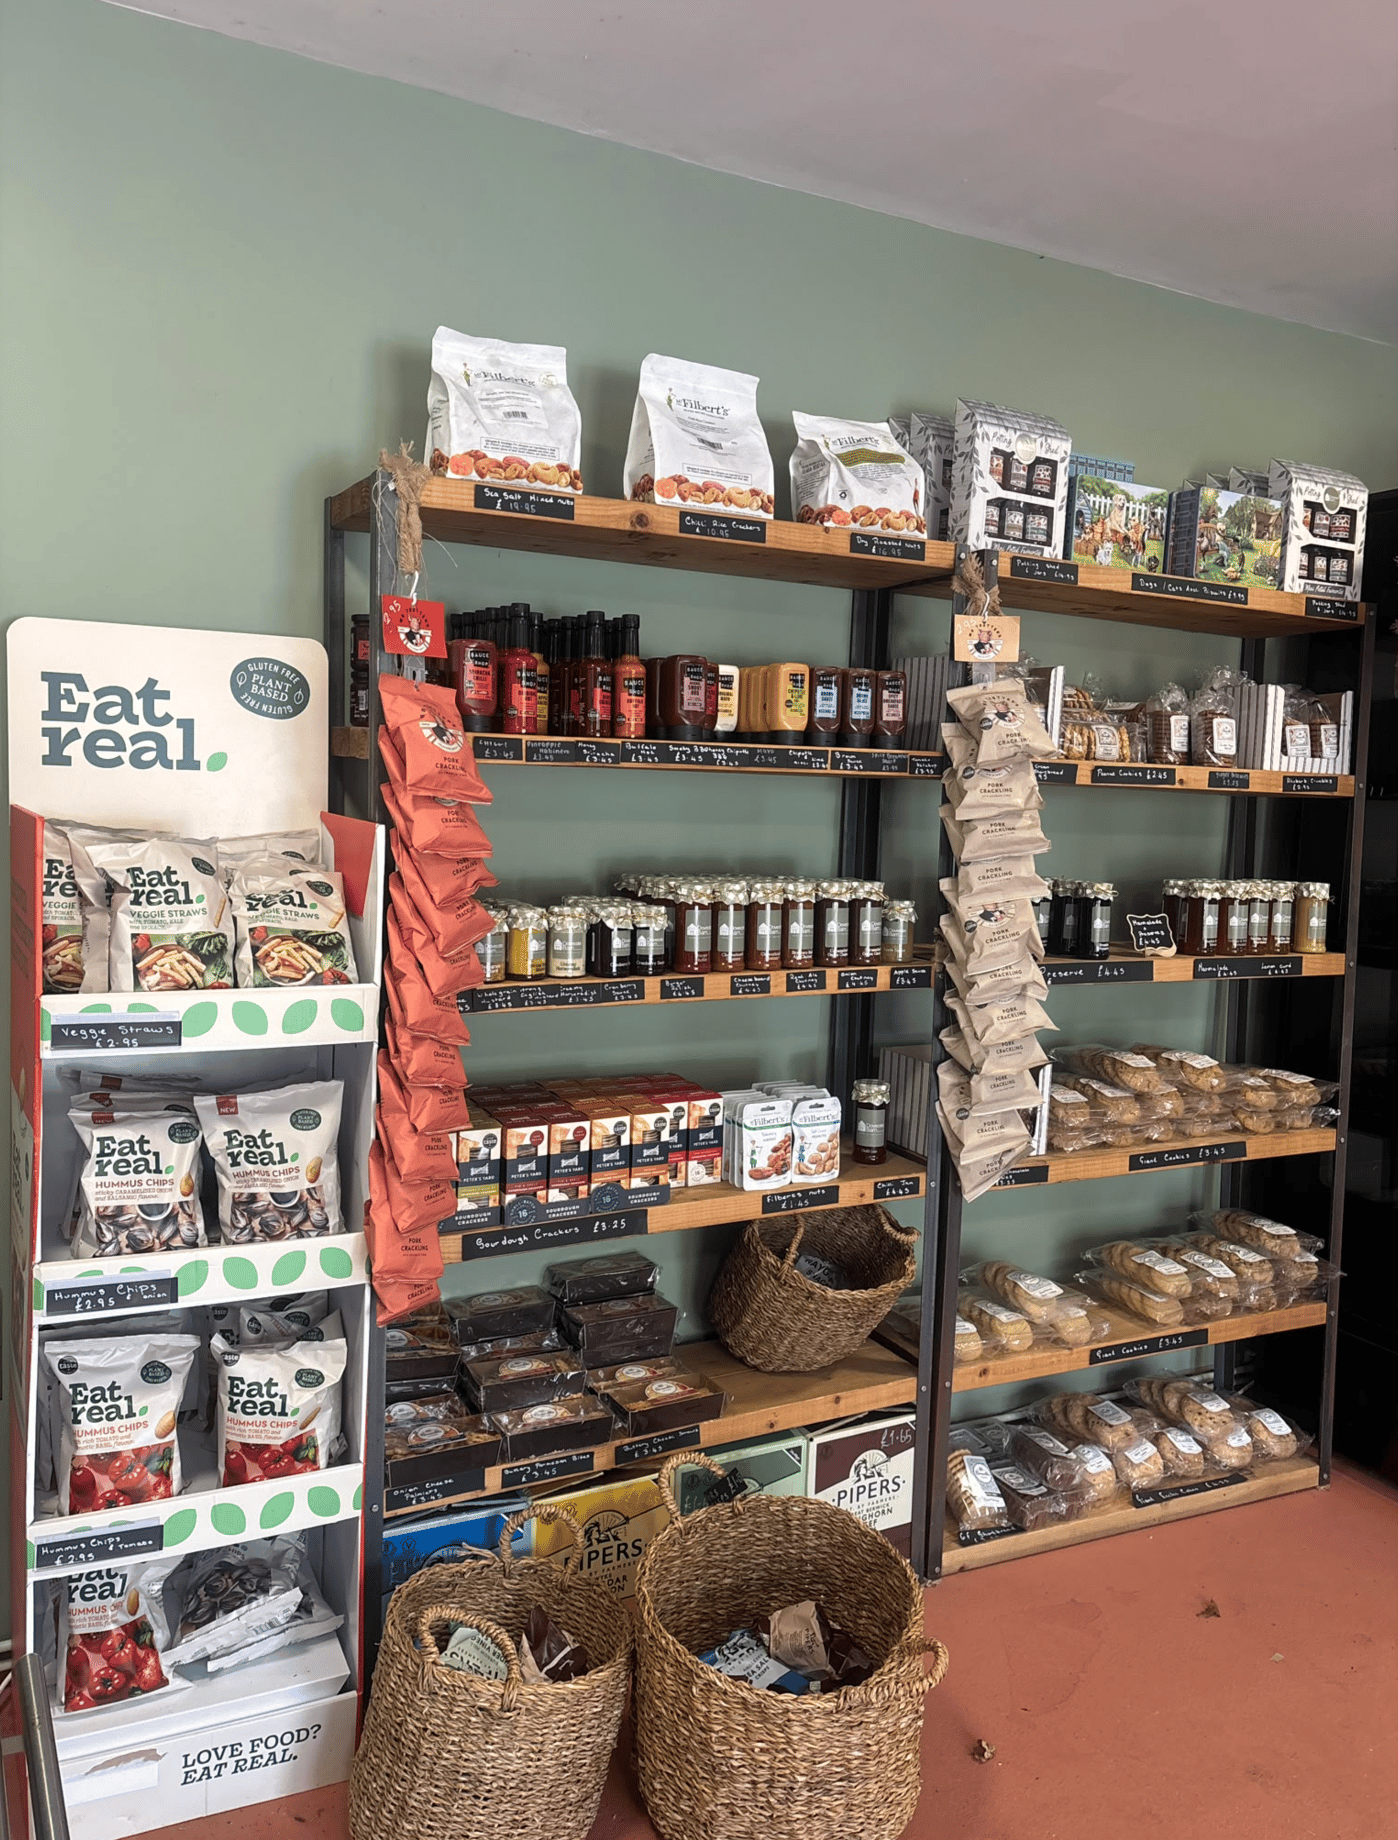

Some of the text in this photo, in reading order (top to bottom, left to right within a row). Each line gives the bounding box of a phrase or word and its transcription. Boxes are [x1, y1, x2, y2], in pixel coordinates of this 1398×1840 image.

[682, 398, 730, 417] Filbert's
[483, 487, 554, 504] Sea Salt Mixed
[711, 519, 761, 532] Rice Crackers
[855, 535, 902, 547] Dry Roasted
[247, 662, 301, 685] GLUTEN FREE
[251, 673, 293, 693] PLANT
[41, 671, 175, 727] Eat
[250, 683, 289, 702] BASED
[240, 692, 294, 715] GLUTEN FREE
[443, 755, 461, 765] PORK
[979, 787, 1014, 795] CRACKLING
[125, 865, 181, 888] Eat
[977, 870, 1014, 881] CRACKLING
[985, 866, 1003, 874] PORK
[129, 907, 208, 919] VEGGIE STRAWS
[282, 908, 320, 920] STRAWS
[985, 930, 1021, 945] CRACKLING
[991, 928, 1010, 937] PORK
[989, 968, 1023, 981] CRACKLING
[603, 982, 637, 992] Cranberry
[996, 1009, 1028, 1022] CRACKLING
[1001, 1006, 1019, 1014] PORK
[61, 1024, 174, 1040] Veggie Straws
[95, 1037, 139, 1049] £2.95
[989, 1078, 1016, 1091] CRACKLING
[219, 1106, 237, 1114] NEW
[983, 1119, 999, 1127] PORK
[222, 1128, 275, 1151] Eat
[95, 1134, 153, 1159] Eat
[1163, 1152, 1190, 1162] Cookies
[1198, 1147, 1226, 1159] £3.45
[232, 1165, 301, 1179] HUMMUS CHIPS
[95, 1178, 175, 1189] HUMMUS CHIPS
[899, 1179, 915, 1187] Jam
[627, 1191, 661, 1200] SOURDOUGH
[808, 1187, 827, 1196] nuts
[629, 1196, 658, 1205] CRACKERS
[780, 1199, 810, 1210] £1.45
[518, 1209, 528, 1219] 16
[545, 1204, 580, 1214] SOURDOUGH
[548, 1210, 578, 1219] CRACKERS
[454, 1211, 492, 1221] SOURDOUGH
[457, 1217, 489, 1226] CRACKERS
[475, 1218, 627, 1249] Sourdough Crackers £3.25
[408, 1237, 422, 1245] PORK
[400, 1243, 429, 1253] CRACKLING
[53, 1282, 157, 1302] Hummus Chips
[74, 1296, 116, 1312] £2.95
[1120, 1335, 1184, 1355] Cookies £3.45
[68, 1380, 124, 1406] Eat
[227, 1375, 279, 1399] Eat
[117, 1420, 149, 1434] CHIPS
[226, 1416, 299, 1429] HUMMUS CHIPS
[880, 1428, 914, 1449] £1.65
[534, 1453, 591, 1470] Parmesan Bites
[520, 1467, 558, 1483] £3.45
[393, 1478, 455, 1496] Onion Cheese
[837, 1475, 902, 1507] PIPERS
[41, 1536, 122, 1556] Hummus Chips
[54, 1552, 96, 1567] £2.95
[754, 1665, 771, 1681] CRISPS
[181, 1723, 323, 1770] LOVE FOOD?
[180, 1746, 300, 1786] EAT REAL.
